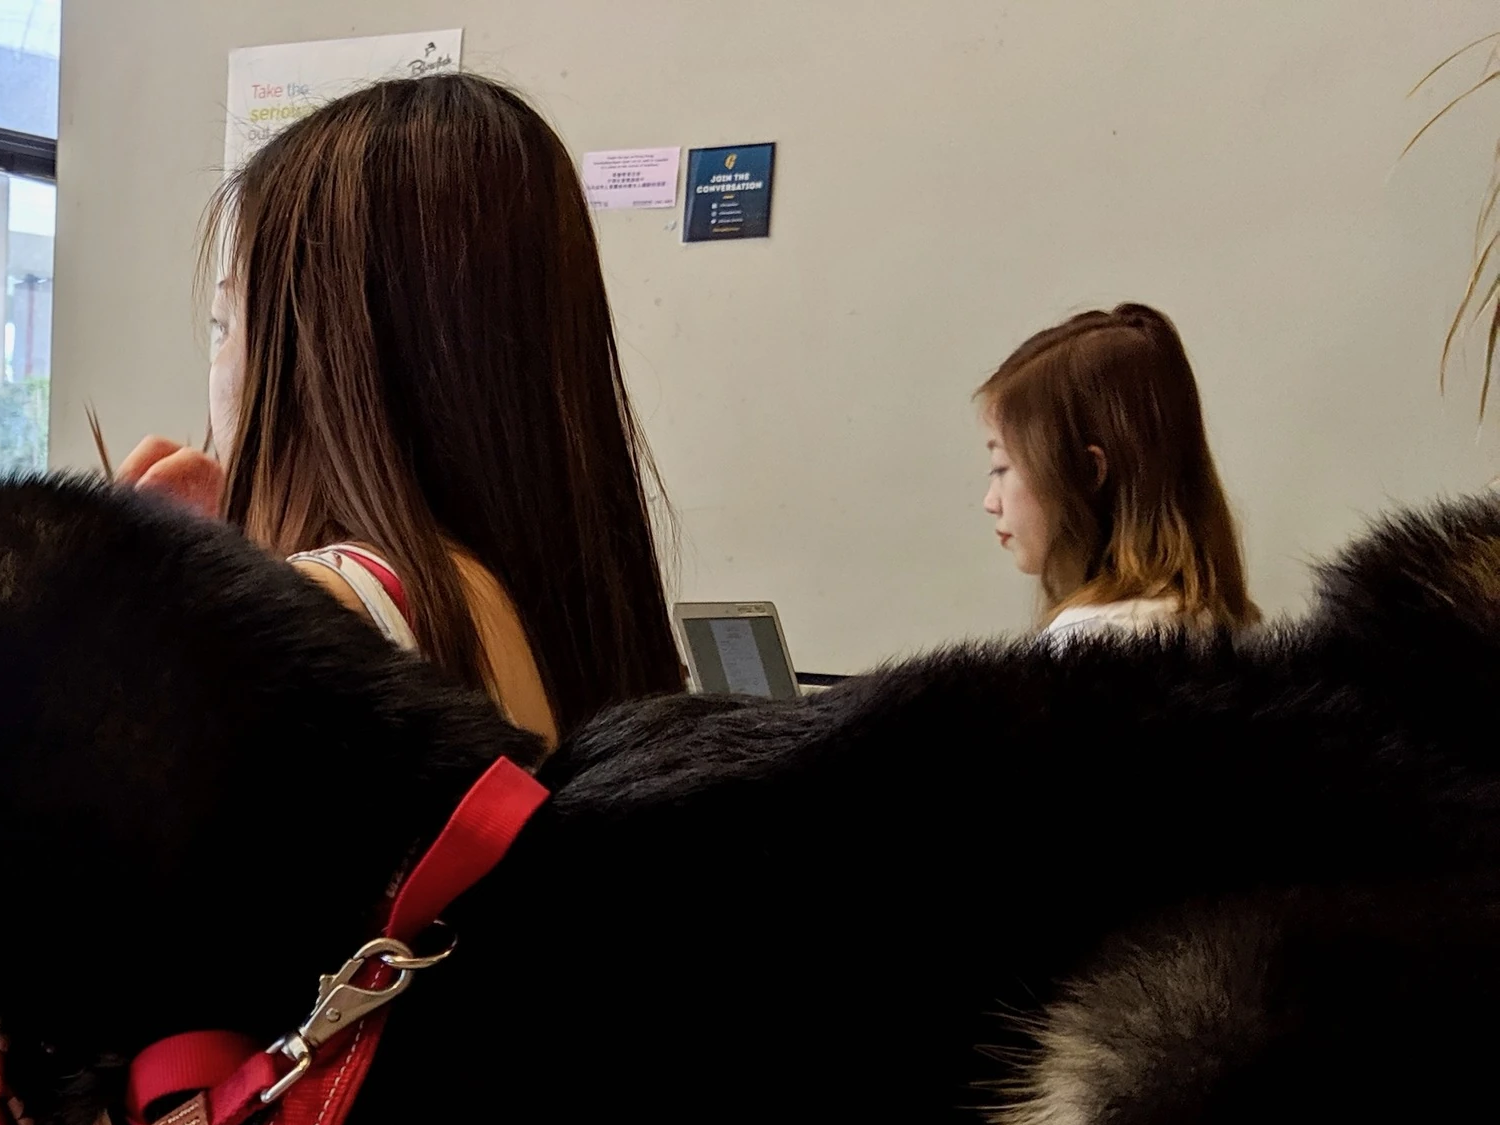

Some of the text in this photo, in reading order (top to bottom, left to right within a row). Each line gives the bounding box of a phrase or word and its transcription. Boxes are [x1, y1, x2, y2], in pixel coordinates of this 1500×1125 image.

[251, 82, 310, 99] Take the
[710, 172, 751, 184] JOIN THE
[696, 181, 763, 194] CONVERSATION
